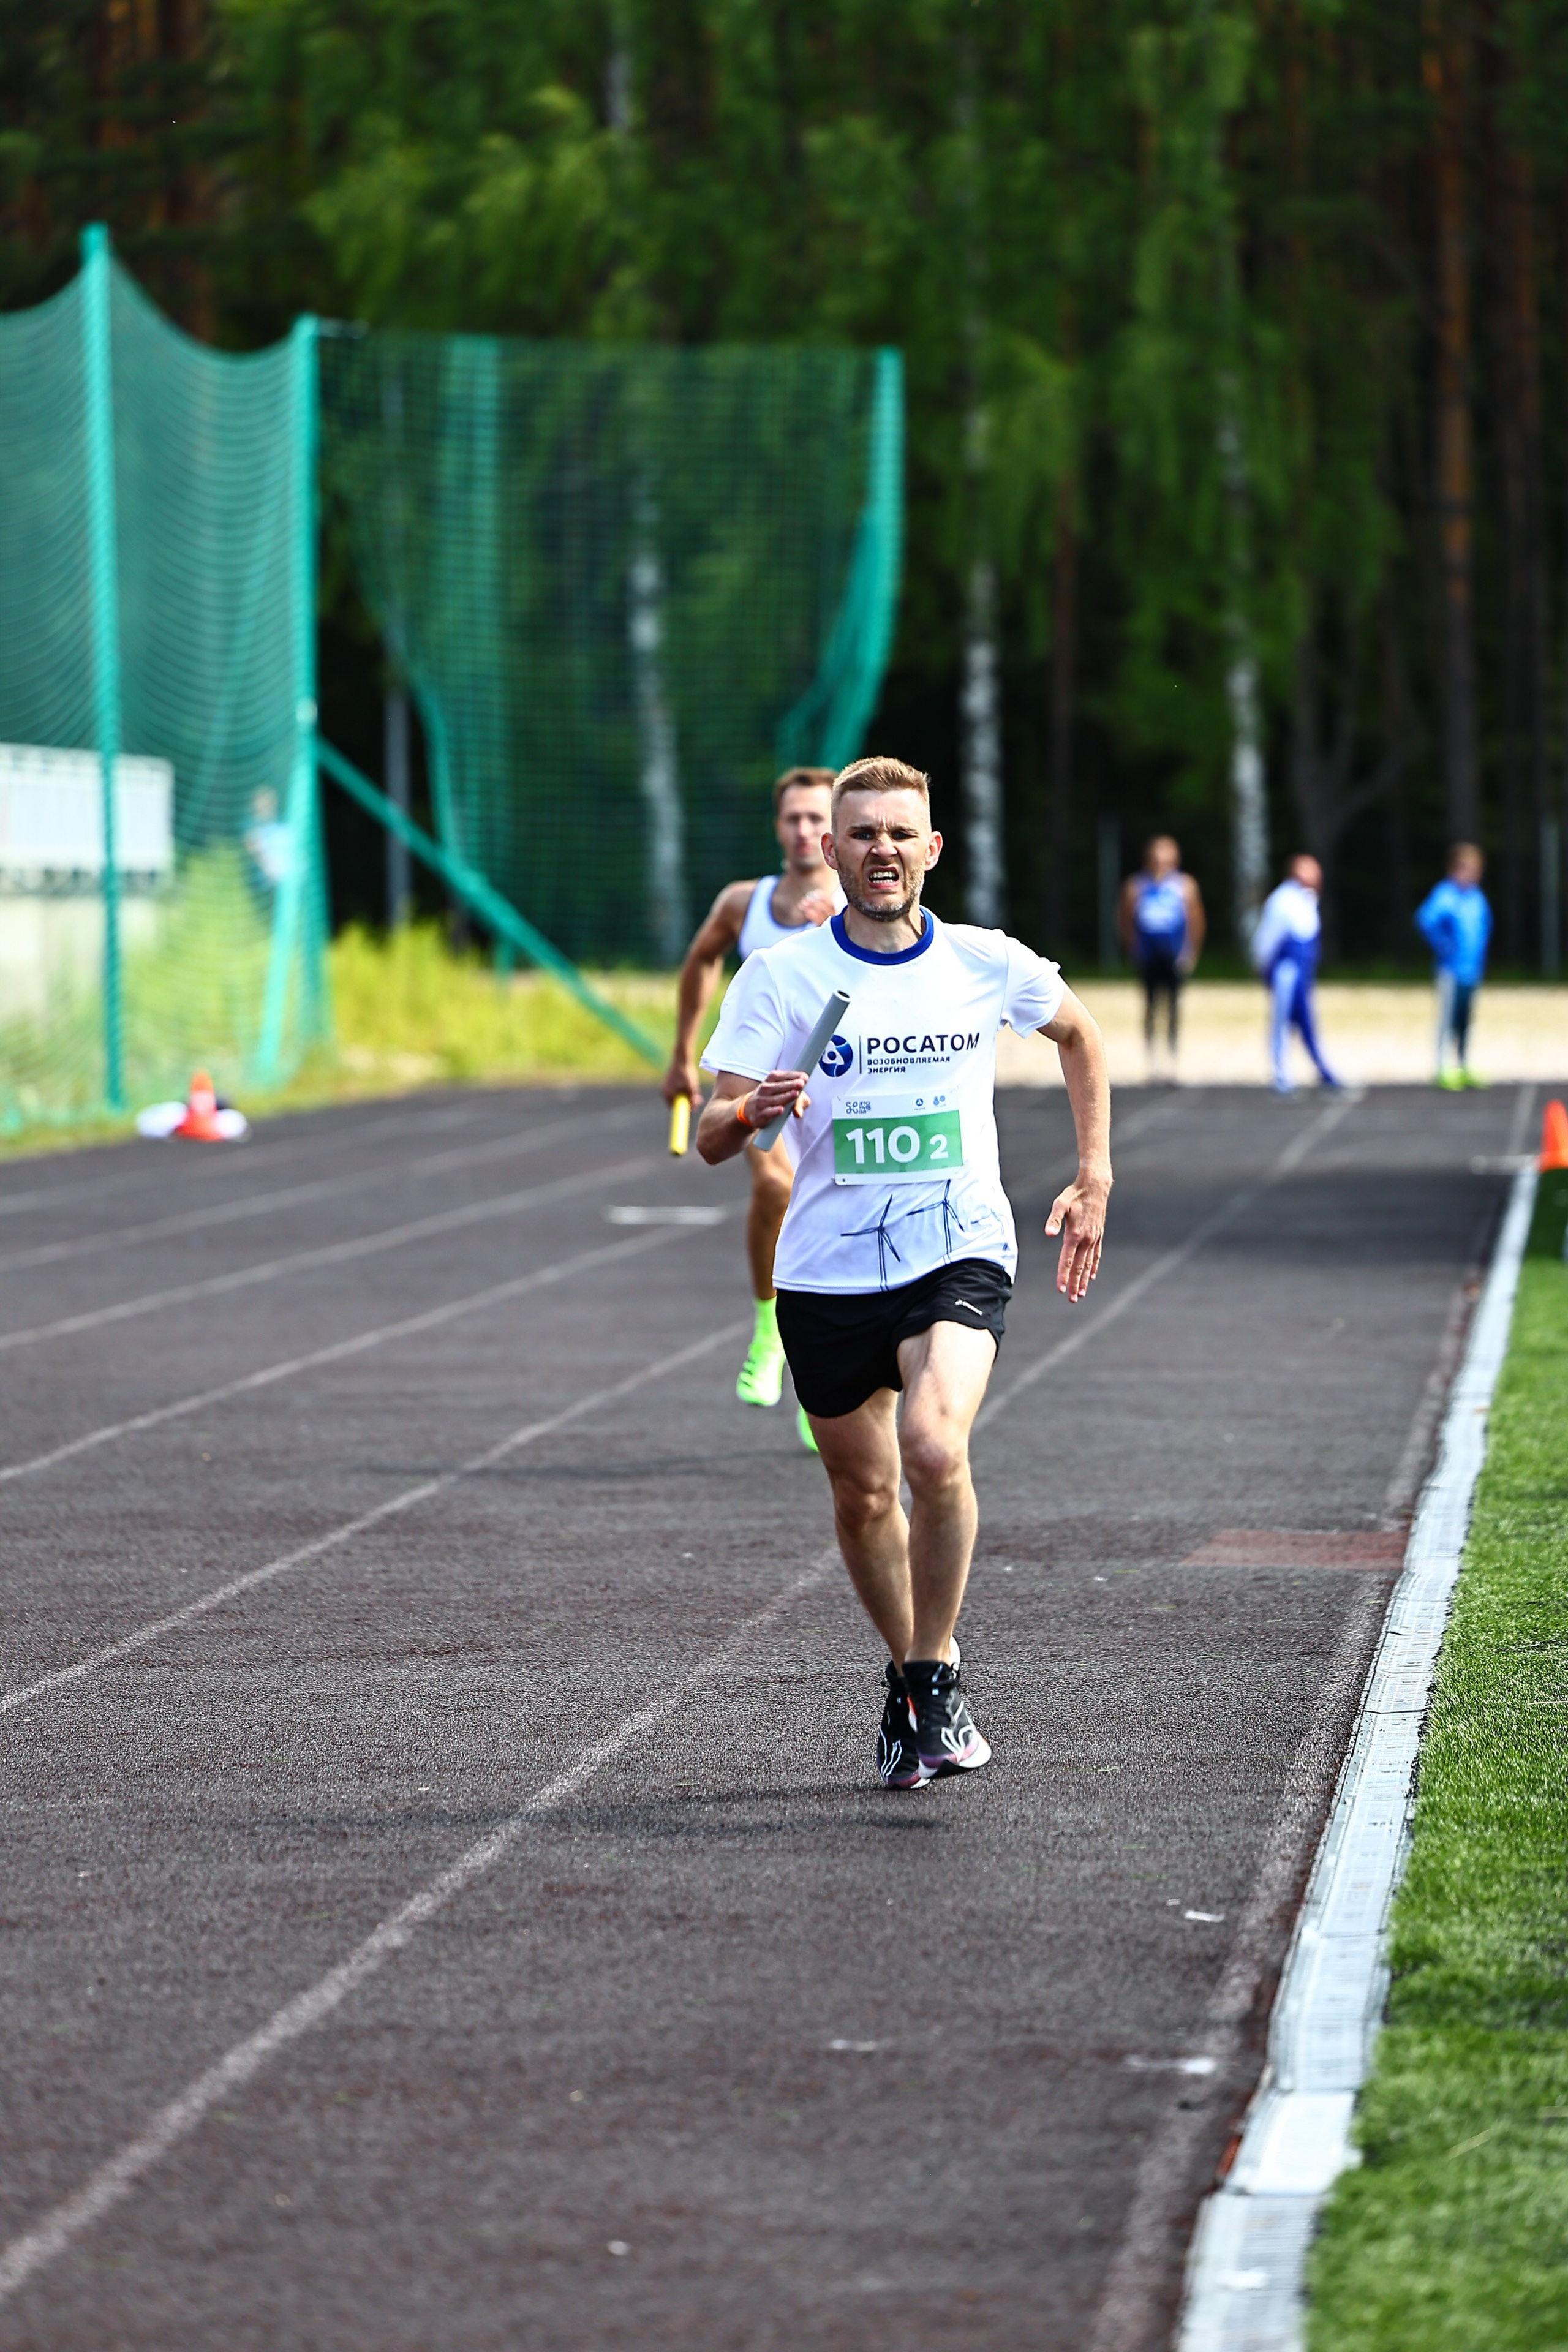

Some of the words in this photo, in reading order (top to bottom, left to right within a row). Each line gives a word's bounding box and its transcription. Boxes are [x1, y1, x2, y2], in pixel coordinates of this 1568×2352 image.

[867, 1033, 980, 1055] РОСАТОМ
[867, 1056, 950, 1065] ВОЗОБНОВЛЯЕМАЯ
[846, 1126, 921, 1164] 110
[929, 1134, 949, 1160] 2
